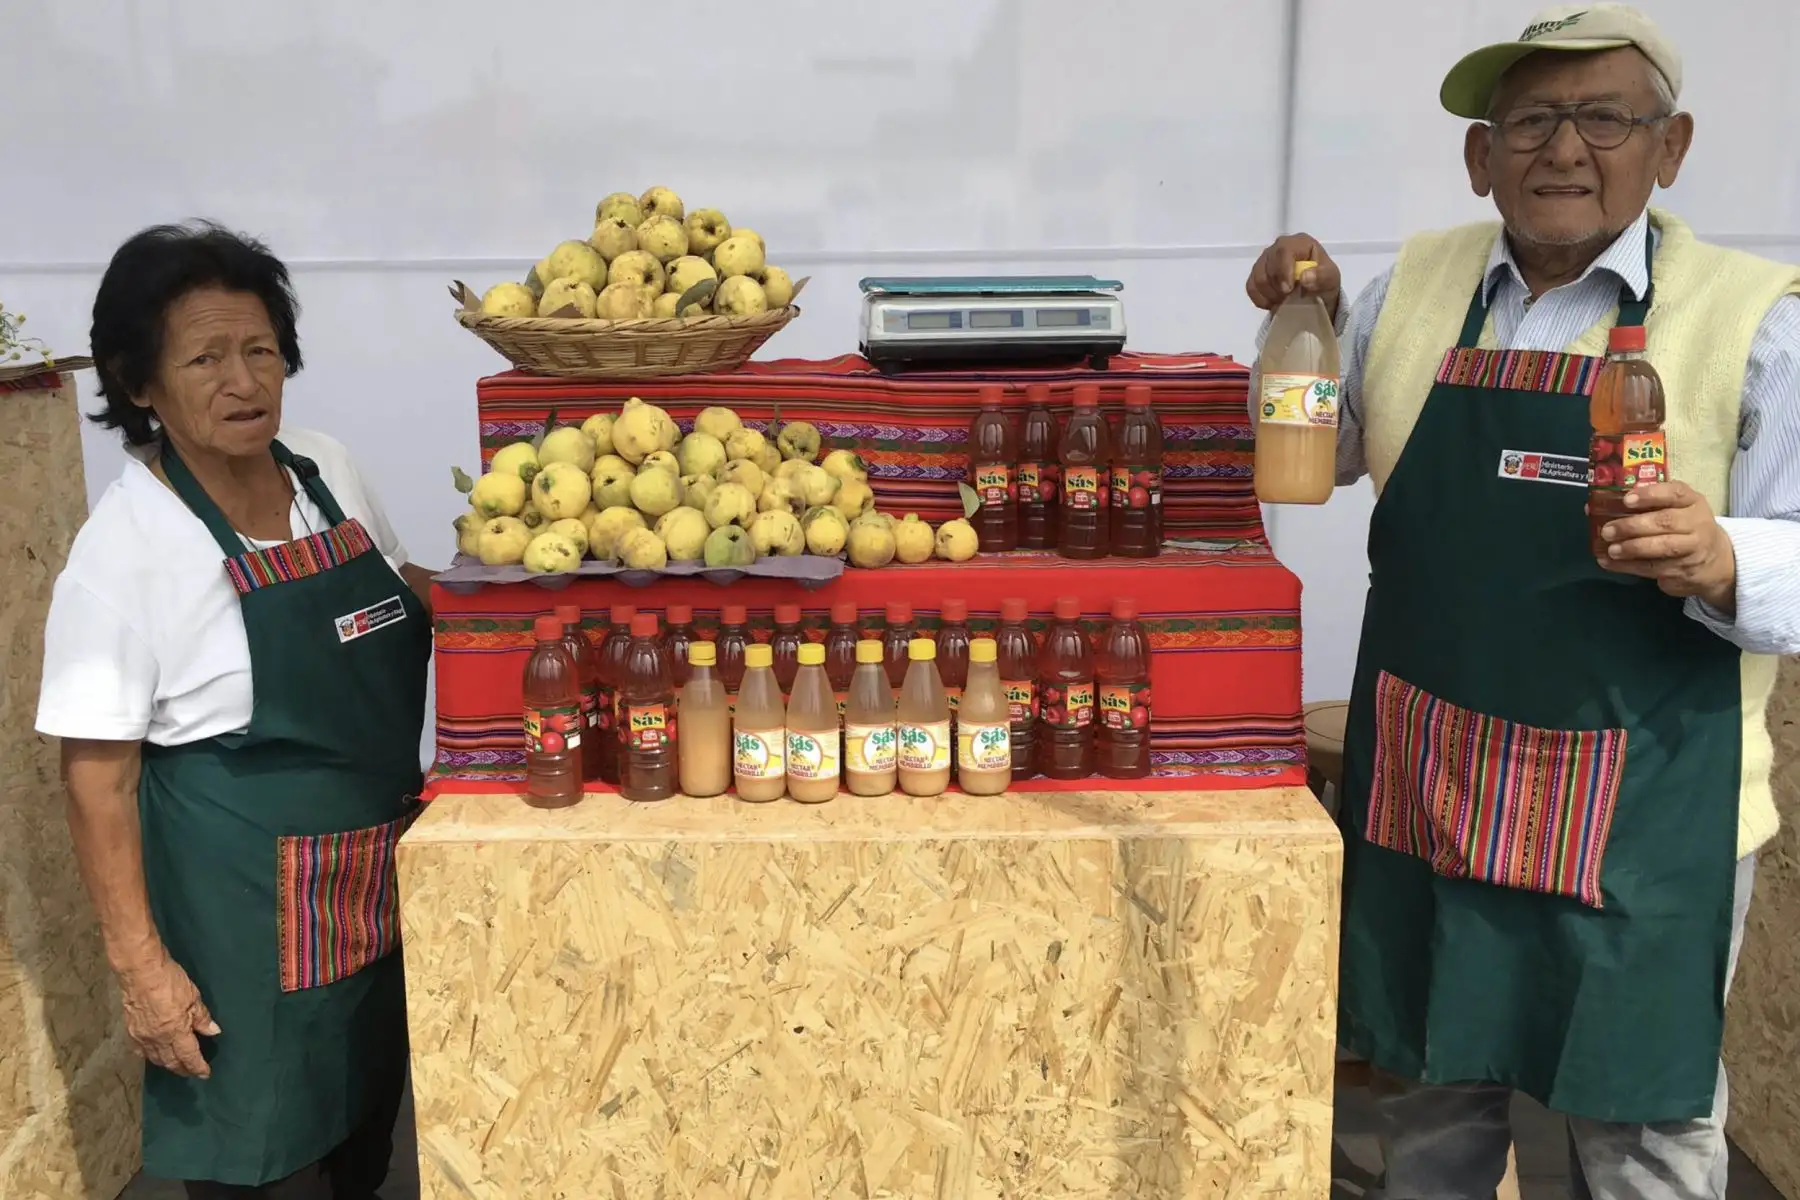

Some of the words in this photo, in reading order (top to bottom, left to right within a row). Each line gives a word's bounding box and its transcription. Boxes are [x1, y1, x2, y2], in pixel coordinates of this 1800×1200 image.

[1314, 380, 1337, 397] sás
[1627, 440, 1662, 459] sás
[632, 711, 662, 726] sás
[736, 734, 759, 750] sás
[788, 735, 813, 752] sás
[872, 728, 896, 745] sás
[900, 728, 927, 743] sás
[980, 728, 1006, 743] sás
